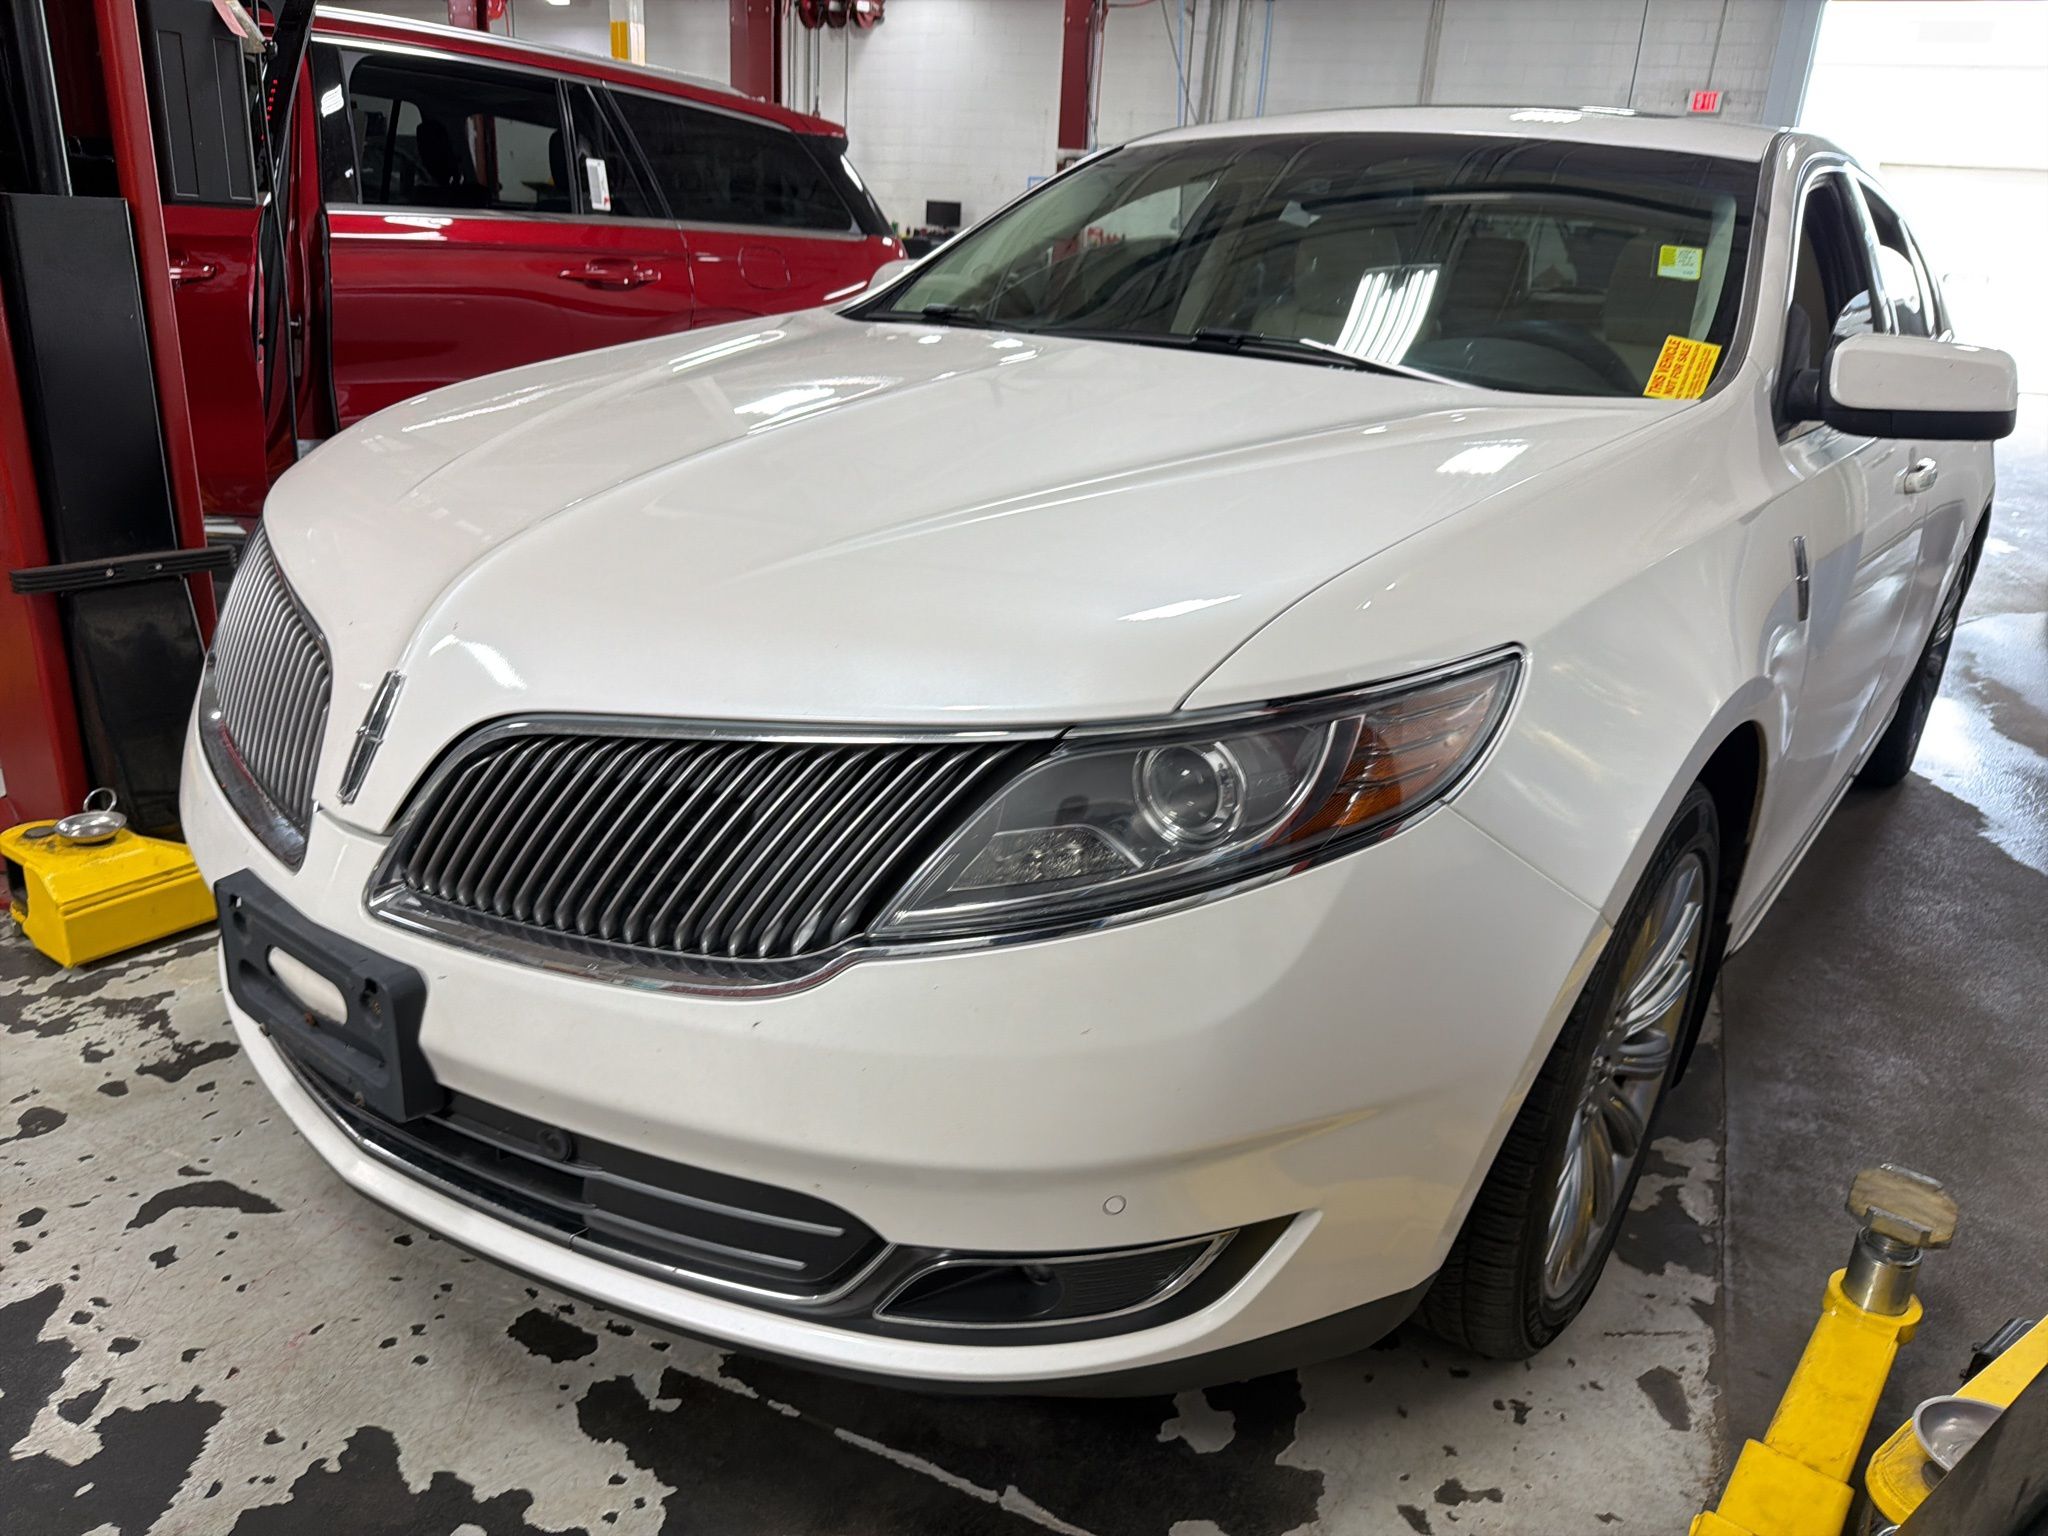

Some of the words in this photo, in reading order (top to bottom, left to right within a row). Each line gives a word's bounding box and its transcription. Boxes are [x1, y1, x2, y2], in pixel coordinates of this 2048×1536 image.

[1693, 92, 1718, 112] EXIT
[1655, 338, 1681, 373] VEHICLE
[1677, 342, 1693, 362] SALE
[1671, 362, 1684, 379] FOR
[1647, 374, 1666, 393] THIS
[1663, 379, 1679, 395] NOT
